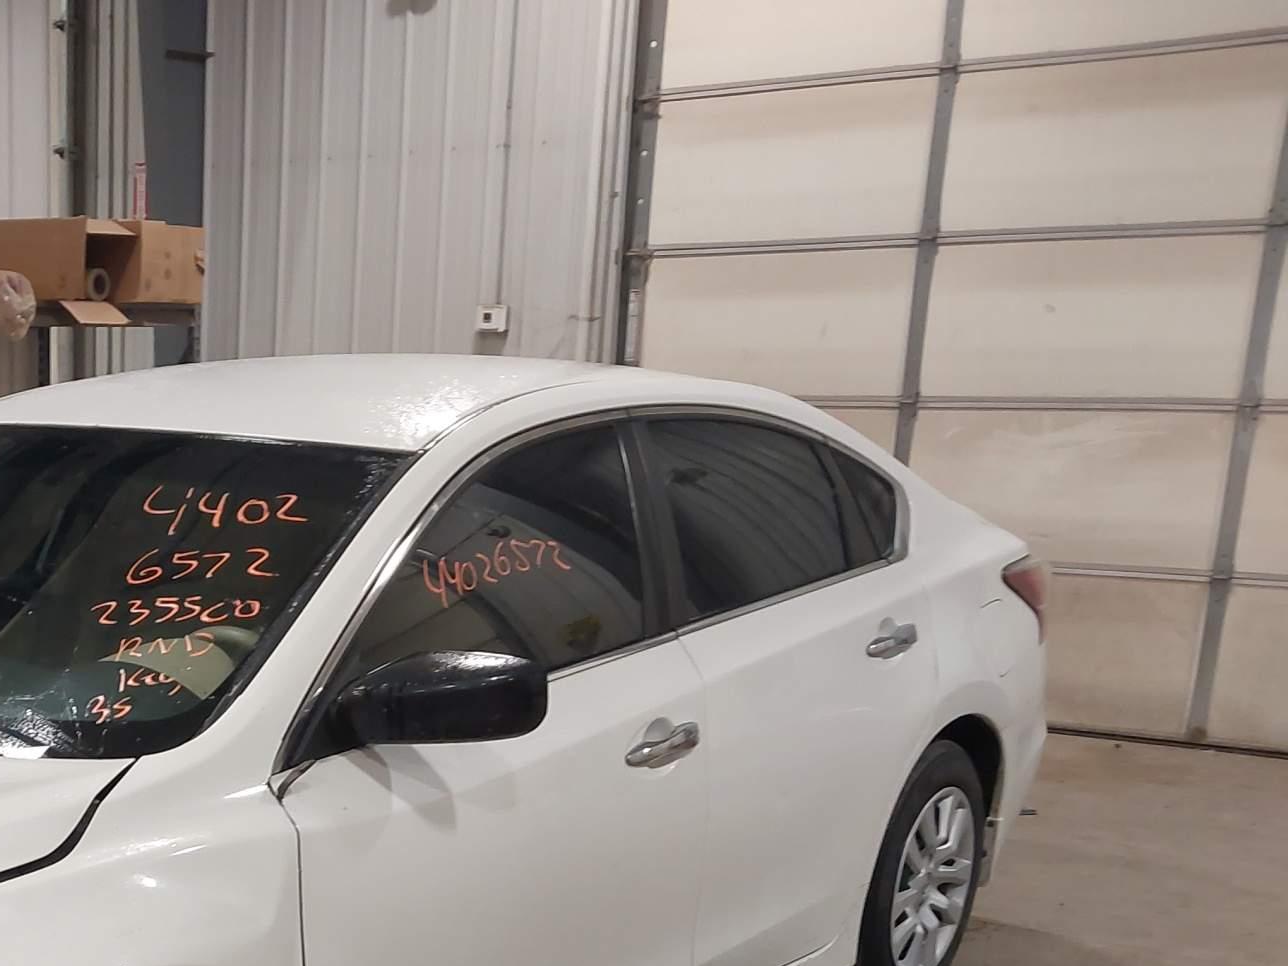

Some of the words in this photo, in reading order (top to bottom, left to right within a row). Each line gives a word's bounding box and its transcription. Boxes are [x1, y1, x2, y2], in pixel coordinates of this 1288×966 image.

[142, 484, 310, 536] 4402
[126, 547, 280, 585] 6572
[423, 539, 572, 609] 44026572
